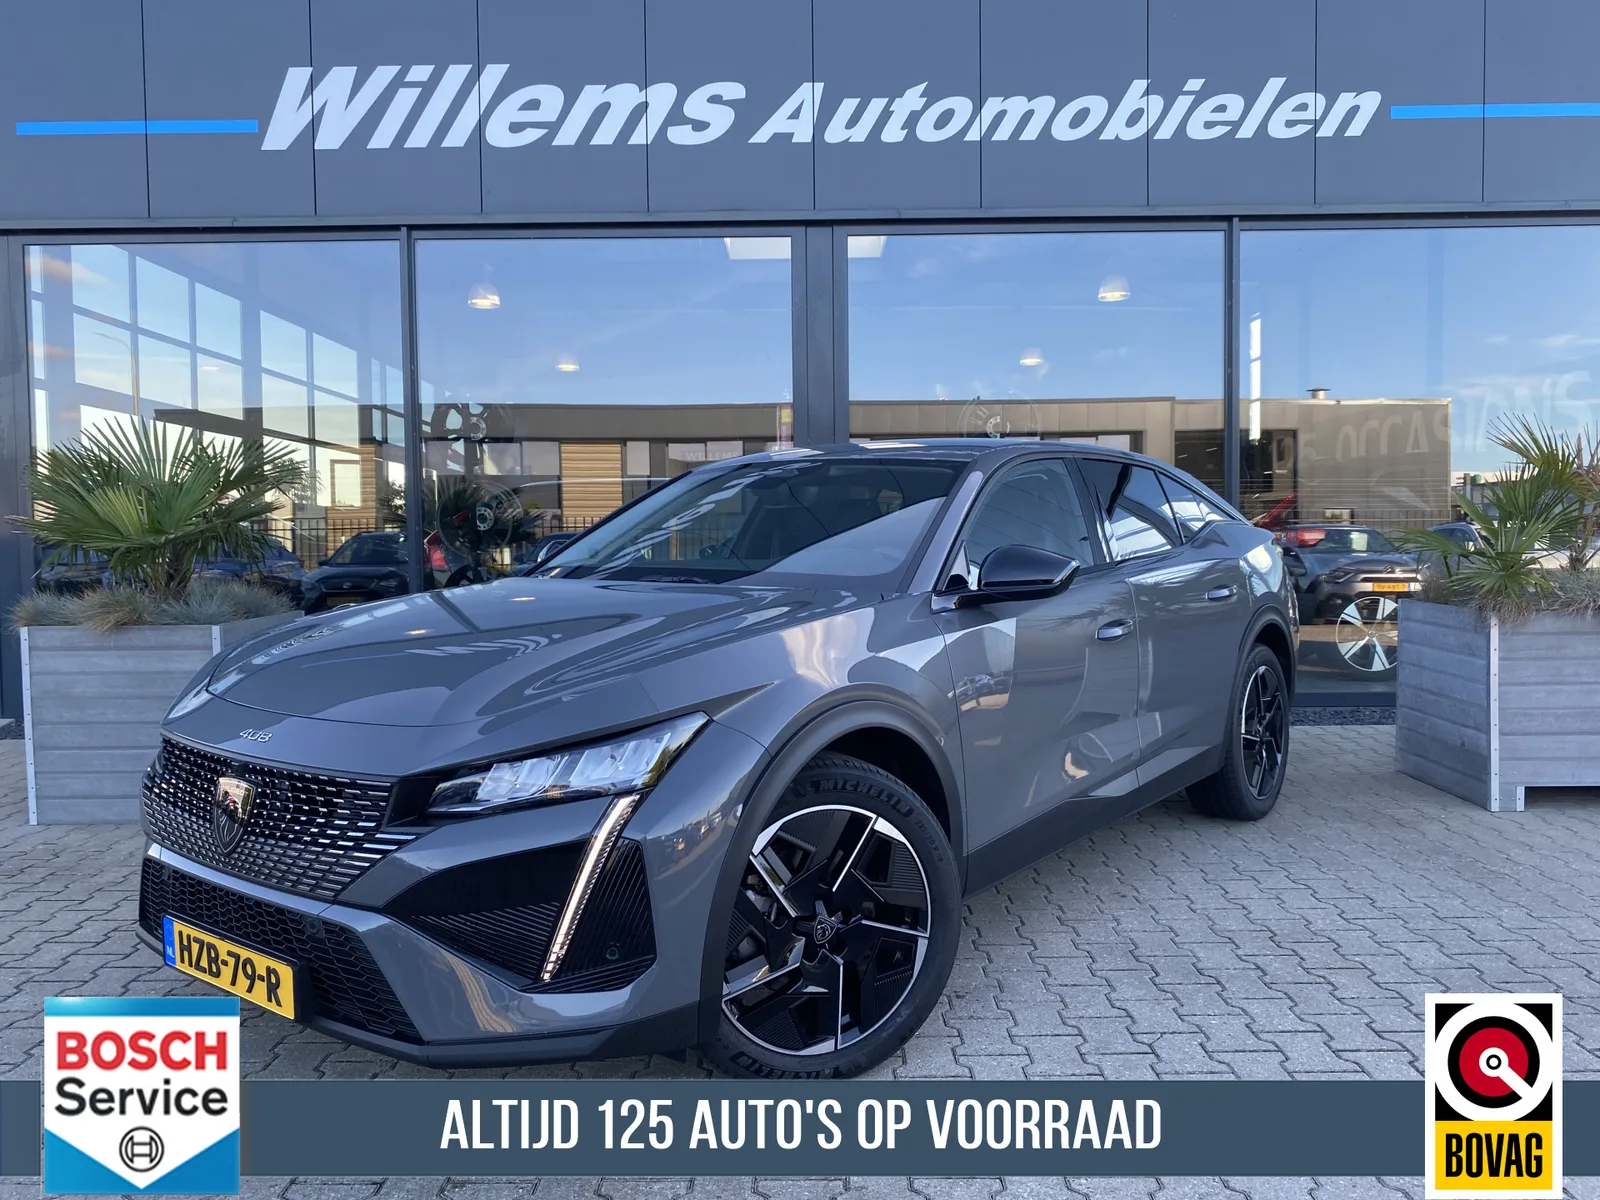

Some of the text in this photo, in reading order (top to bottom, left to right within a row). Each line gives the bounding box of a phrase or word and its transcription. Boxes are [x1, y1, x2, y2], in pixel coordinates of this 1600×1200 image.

[260, 64, 1381, 150] Willems Automobielen
[819, 777, 910, 818] MICHELIN
[178, 929, 283, 1008] HZB-79-R
